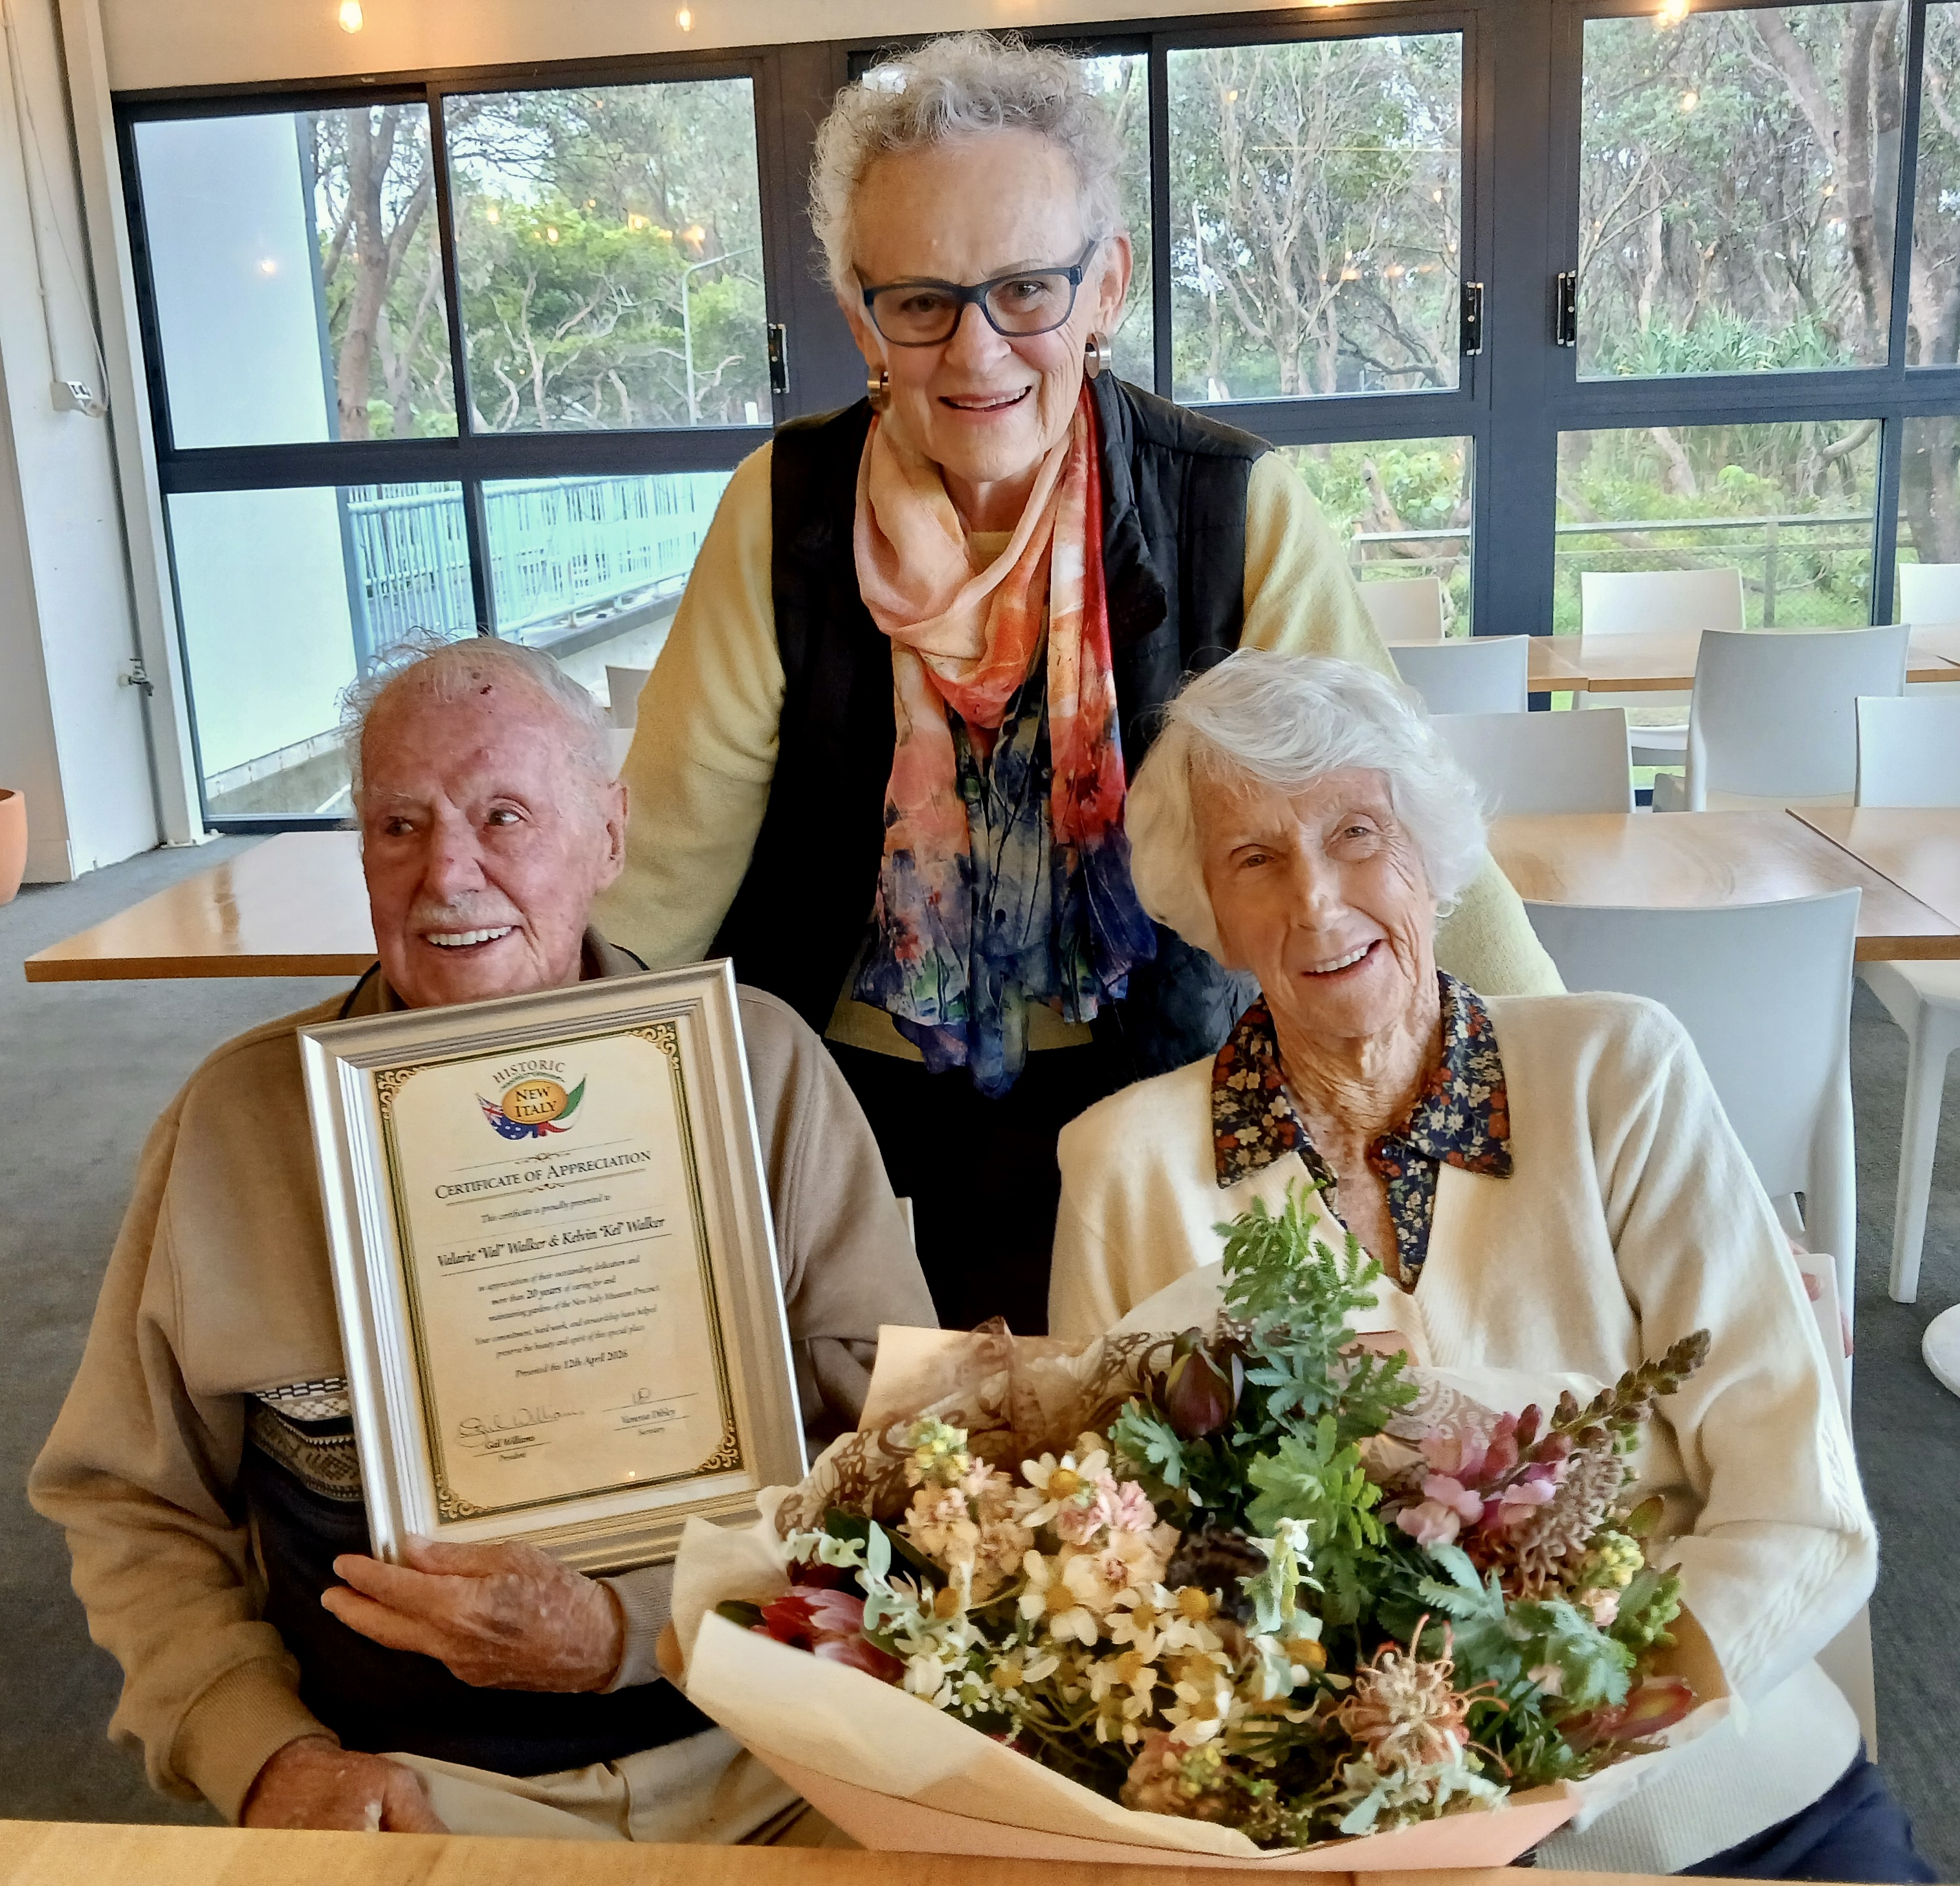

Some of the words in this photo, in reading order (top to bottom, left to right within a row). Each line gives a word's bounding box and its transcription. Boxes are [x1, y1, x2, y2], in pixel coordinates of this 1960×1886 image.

[492, 1059, 566, 1083] HISTORIC
[515, 1087, 550, 1102] NEW
[514, 1101, 556, 1117] ITALY
[435, 1173, 522, 1199] CERTIFICATE
[524, 1170, 542, 1182] OF
[547, 1150, 651, 1179] APPRECIATION
[481, 1213, 498, 1223] This
[499, 1208, 533, 1220] certificate
[541, 1200, 568, 1215] proudly
[570, 1193, 603, 1210] presented
[507, 1237, 547, 1254] Walker
[548, 1234, 559, 1247] &
[562, 1228, 597, 1245] Kelvin
[626, 1216, 665, 1233] Walker
[527, 1289, 538, 1298] 20
[538, 1287, 562, 1300] years
[584, 1353, 605, 1367] April
